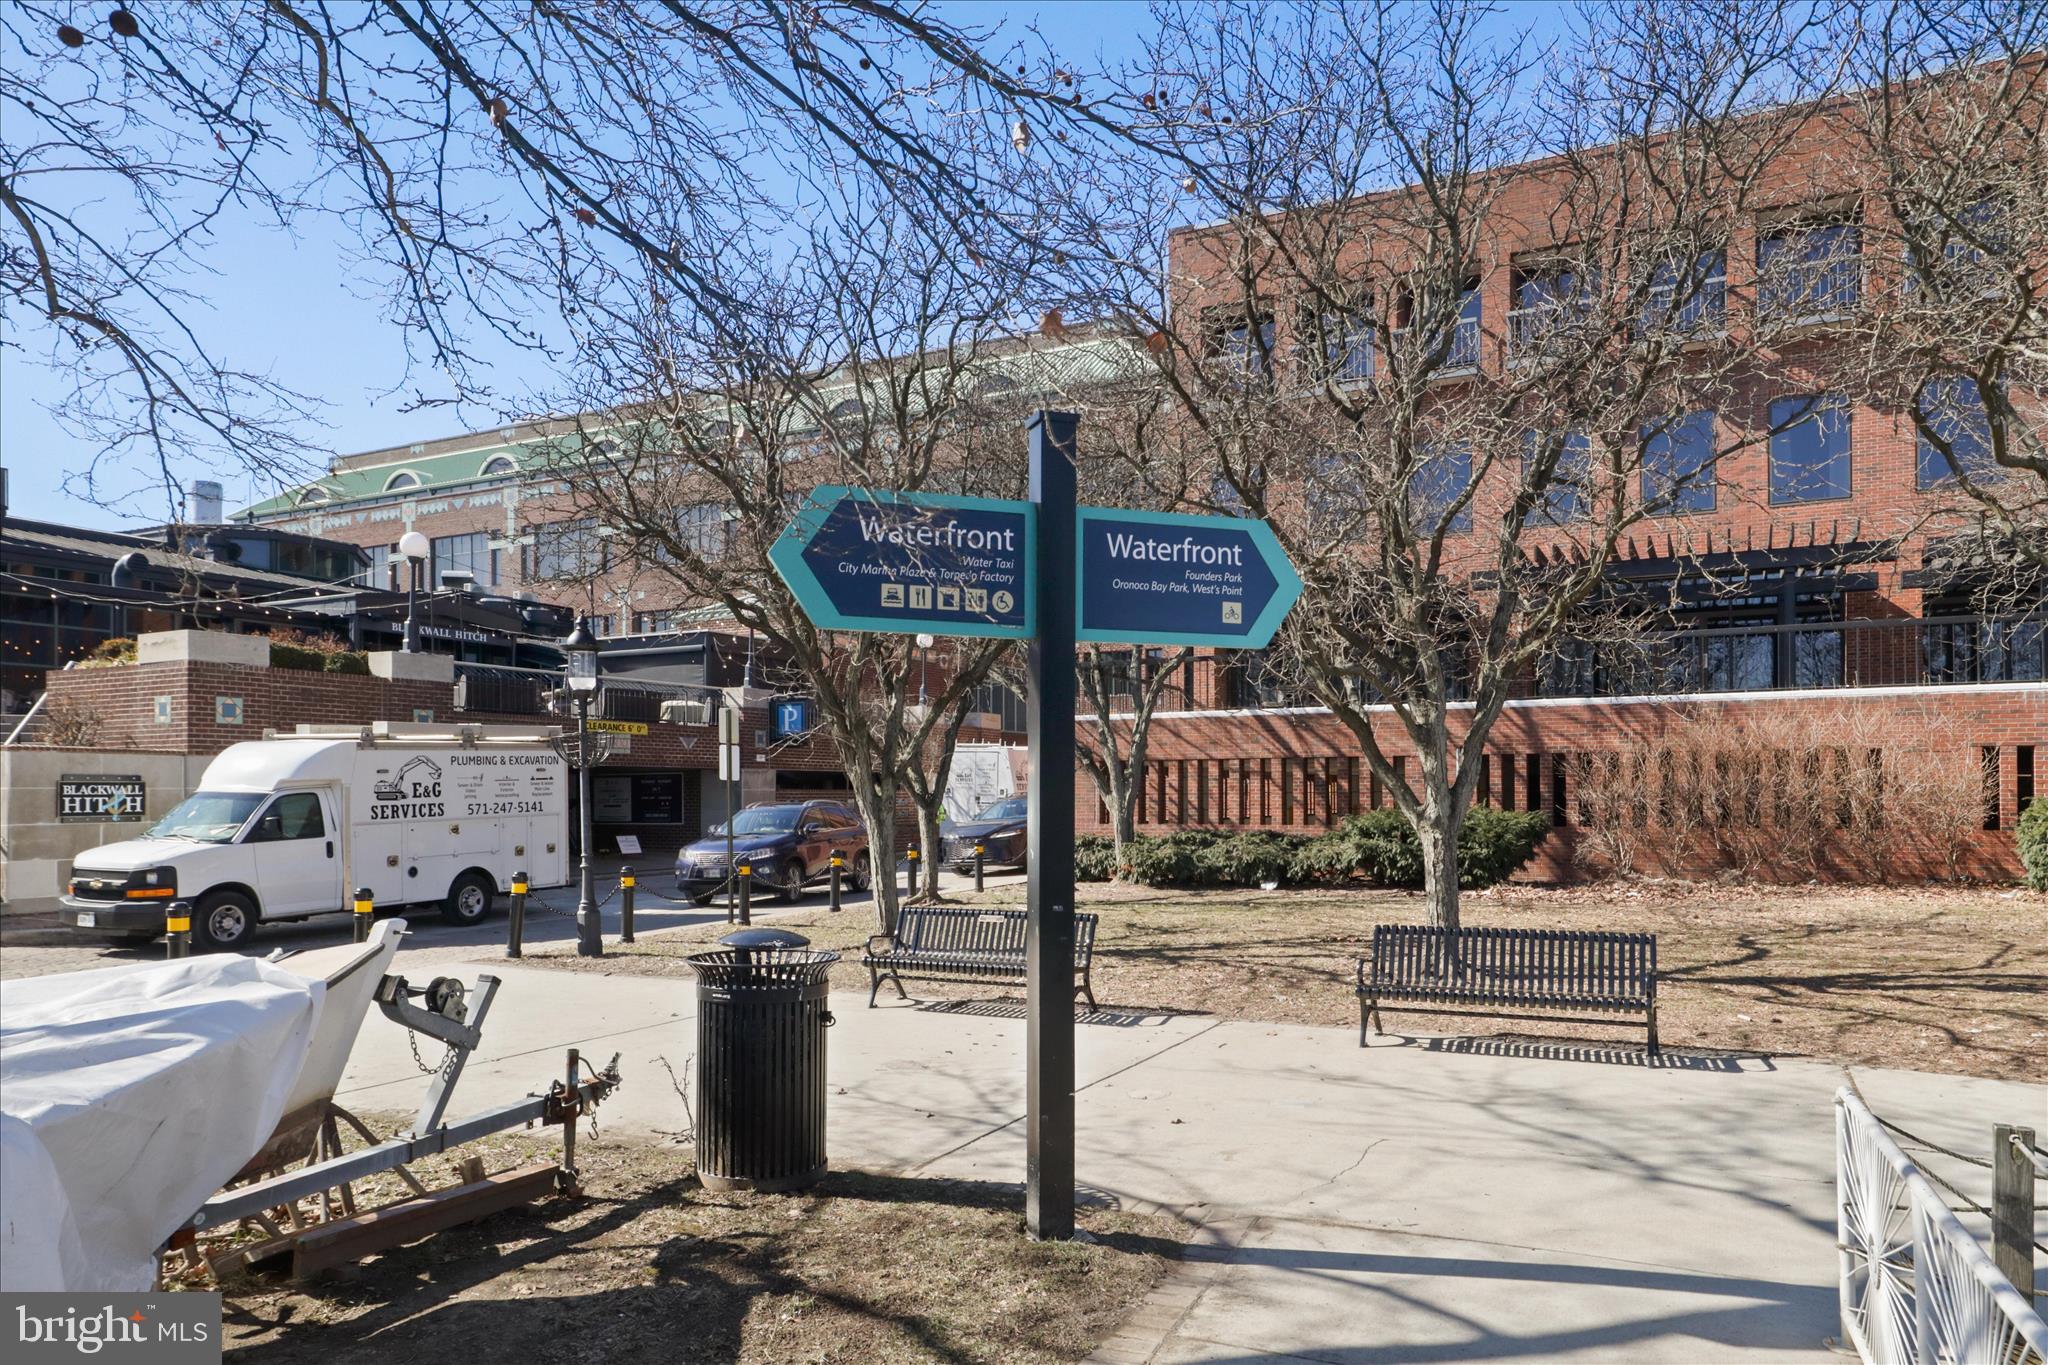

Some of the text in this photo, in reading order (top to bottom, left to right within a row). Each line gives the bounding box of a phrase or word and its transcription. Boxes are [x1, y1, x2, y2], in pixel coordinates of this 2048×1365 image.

[860, 514, 1014, 551] Waterfront
[1106, 532, 1242, 566] Waterfront
[961, 556, 1014, 569] Water Taxi
[838, 561, 859, 576] City
[861, 563, 897, 576] Marina
[980, 570, 1014, 585] Factory
[1185, 570, 1242, 583] Founders Park
[1112, 578, 1242, 596] Oronoco Bay Park, West's Point
[391, 622, 487, 642] BLKWALL HITCH
[782, 708, 798, 731] P
[450, 755, 559, 766] PLUMBING & EXCAVATION
[62, 785, 143, 795] BLACKWALL
[412, 782, 442, 798] E&G
[370, 802, 445, 820] SERVICES
[467, 801, 544, 815] 571-247-5141
